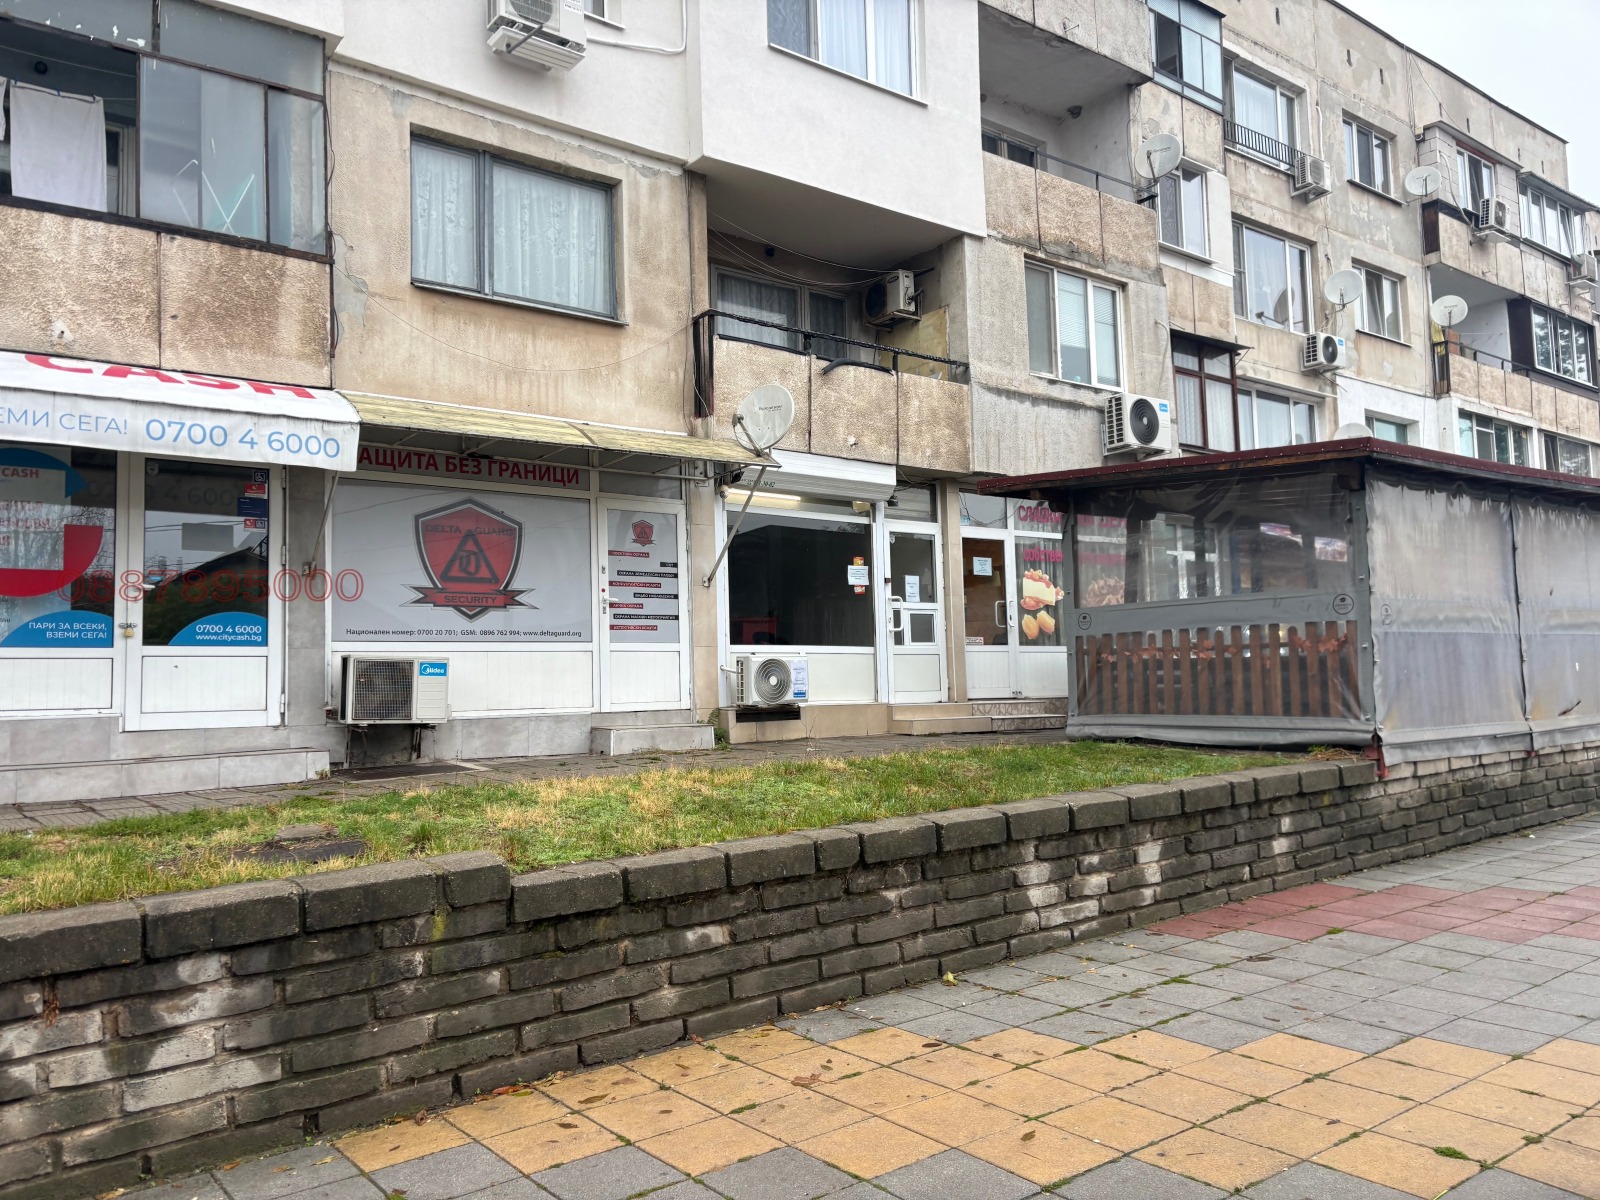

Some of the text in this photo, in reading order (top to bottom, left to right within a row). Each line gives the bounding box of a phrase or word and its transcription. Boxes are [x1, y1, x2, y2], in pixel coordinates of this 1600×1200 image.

[0, 406, 340, 458] МИ СЕГА! 0700 4 6000
[358, 447, 579, 487] АЩИТА БЕЗ ГРАНИЦИ
[2, 467, 39, 479] CASH
[426, 524, 514, 536] DELTA GUARD
[444, 595, 497, 604] SECURITY
[28, 622, 107, 631] ПАРИ ЗА ВСЕКИ,
[196, 624, 262, 634] 0700 4 6000
[46, 631, 107, 639] ВЗЕМИ СЕГА!
[195, 633, 262, 642] www.citycash.bg
[346, 628, 390, 636] Национален
[444, 629, 458, 637] 701;
[508, 629, 522, 637] 994;
[522, 629, 582, 638] www.deltaguard.org
